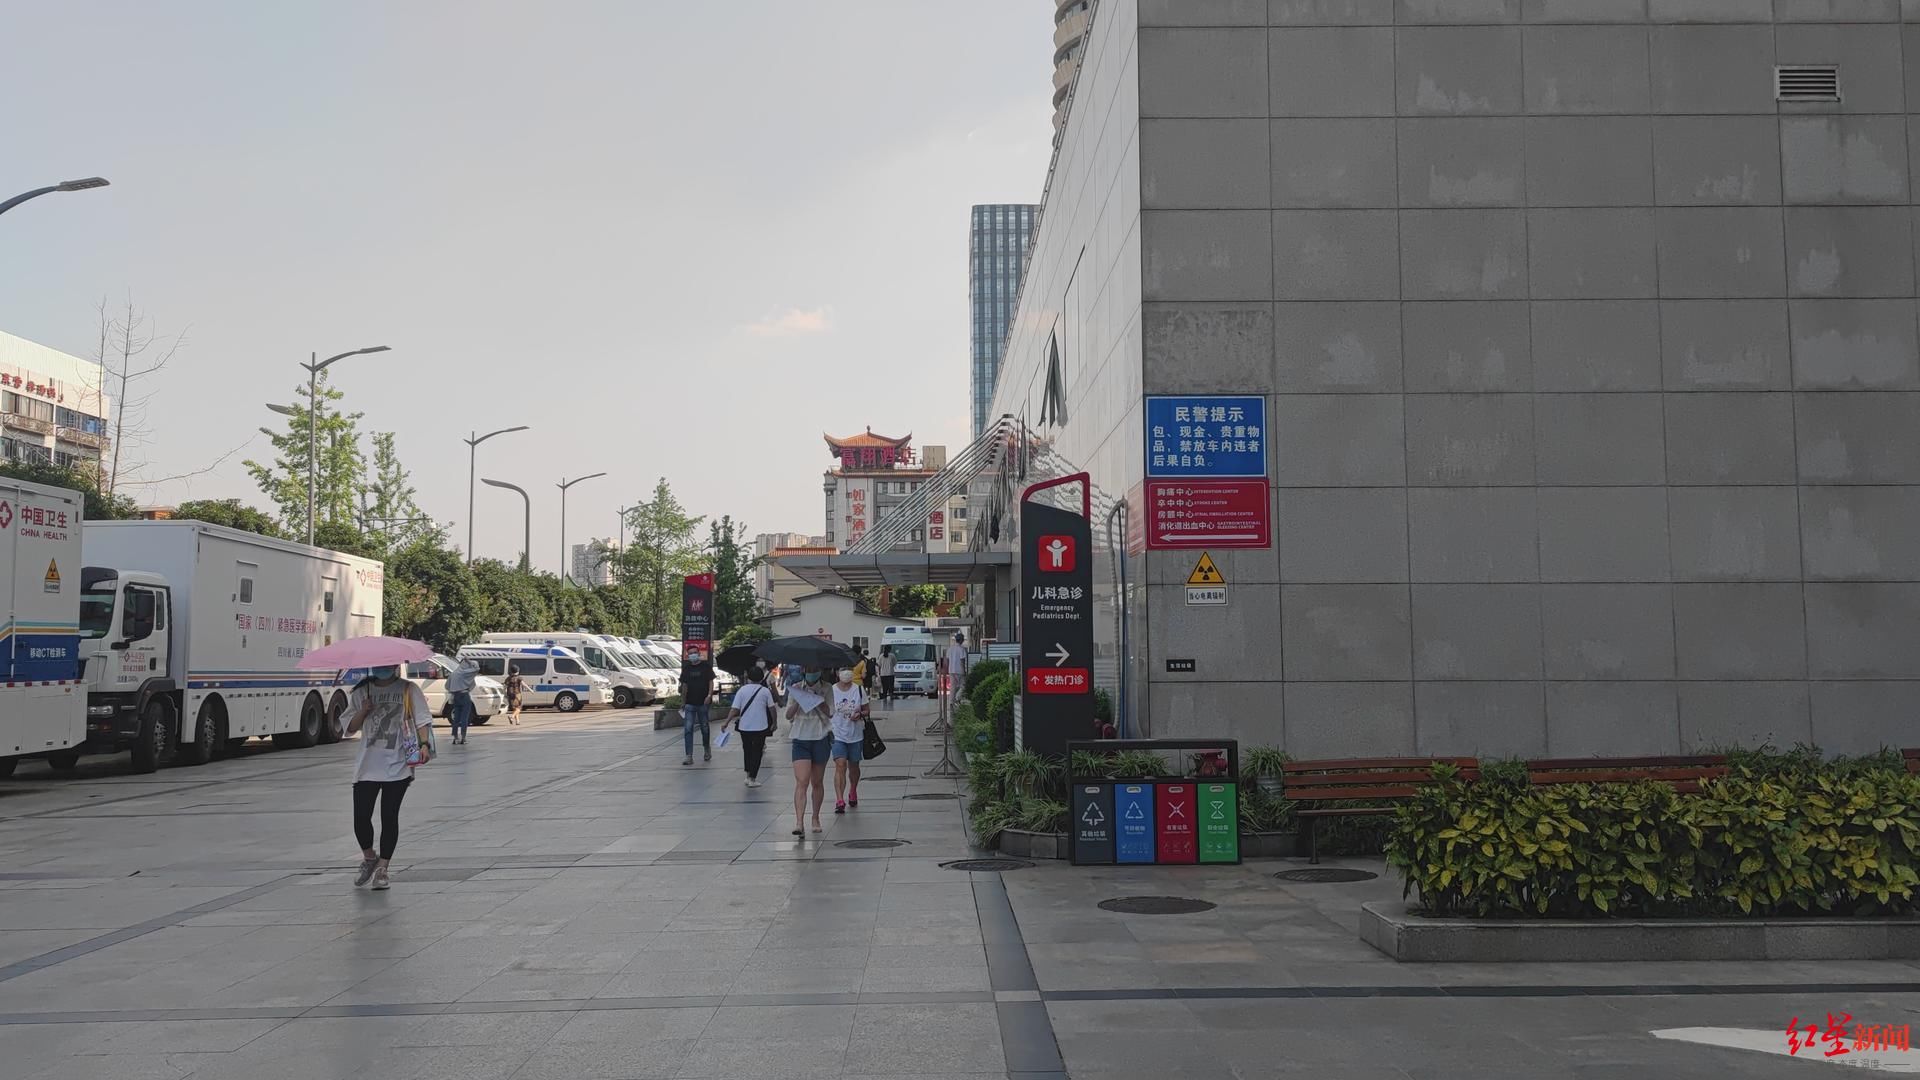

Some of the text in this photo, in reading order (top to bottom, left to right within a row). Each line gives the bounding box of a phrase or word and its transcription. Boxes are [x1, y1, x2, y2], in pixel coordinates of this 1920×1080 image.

[1175, 406, 1244, 423] 民警提示
[1152, 425, 1260, 438] 包、现金、贵重物
[1152, 440, 1260, 453] 品，禁放车内违者
[1152, 454, 1214, 467] 后果自负。
[1157, 487, 1194, 497] 胸痛中心
[1157, 499, 1194, 508] 卒中中心
[21, 505, 67, 529] 中国卫生
[928, 511, 944, 540] 酒店
[1158, 521, 1215, 530] 消化道出血中心
[20, 528, 68, 541] CHINA HEALTH
[1032, 586, 1083, 600] 儿科急诊
[1040, 604, 1075, 612] Emergency
[1032, 612, 1064, 620] Pediatrics
[1044, 674, 1084, 686] 发热门诊
